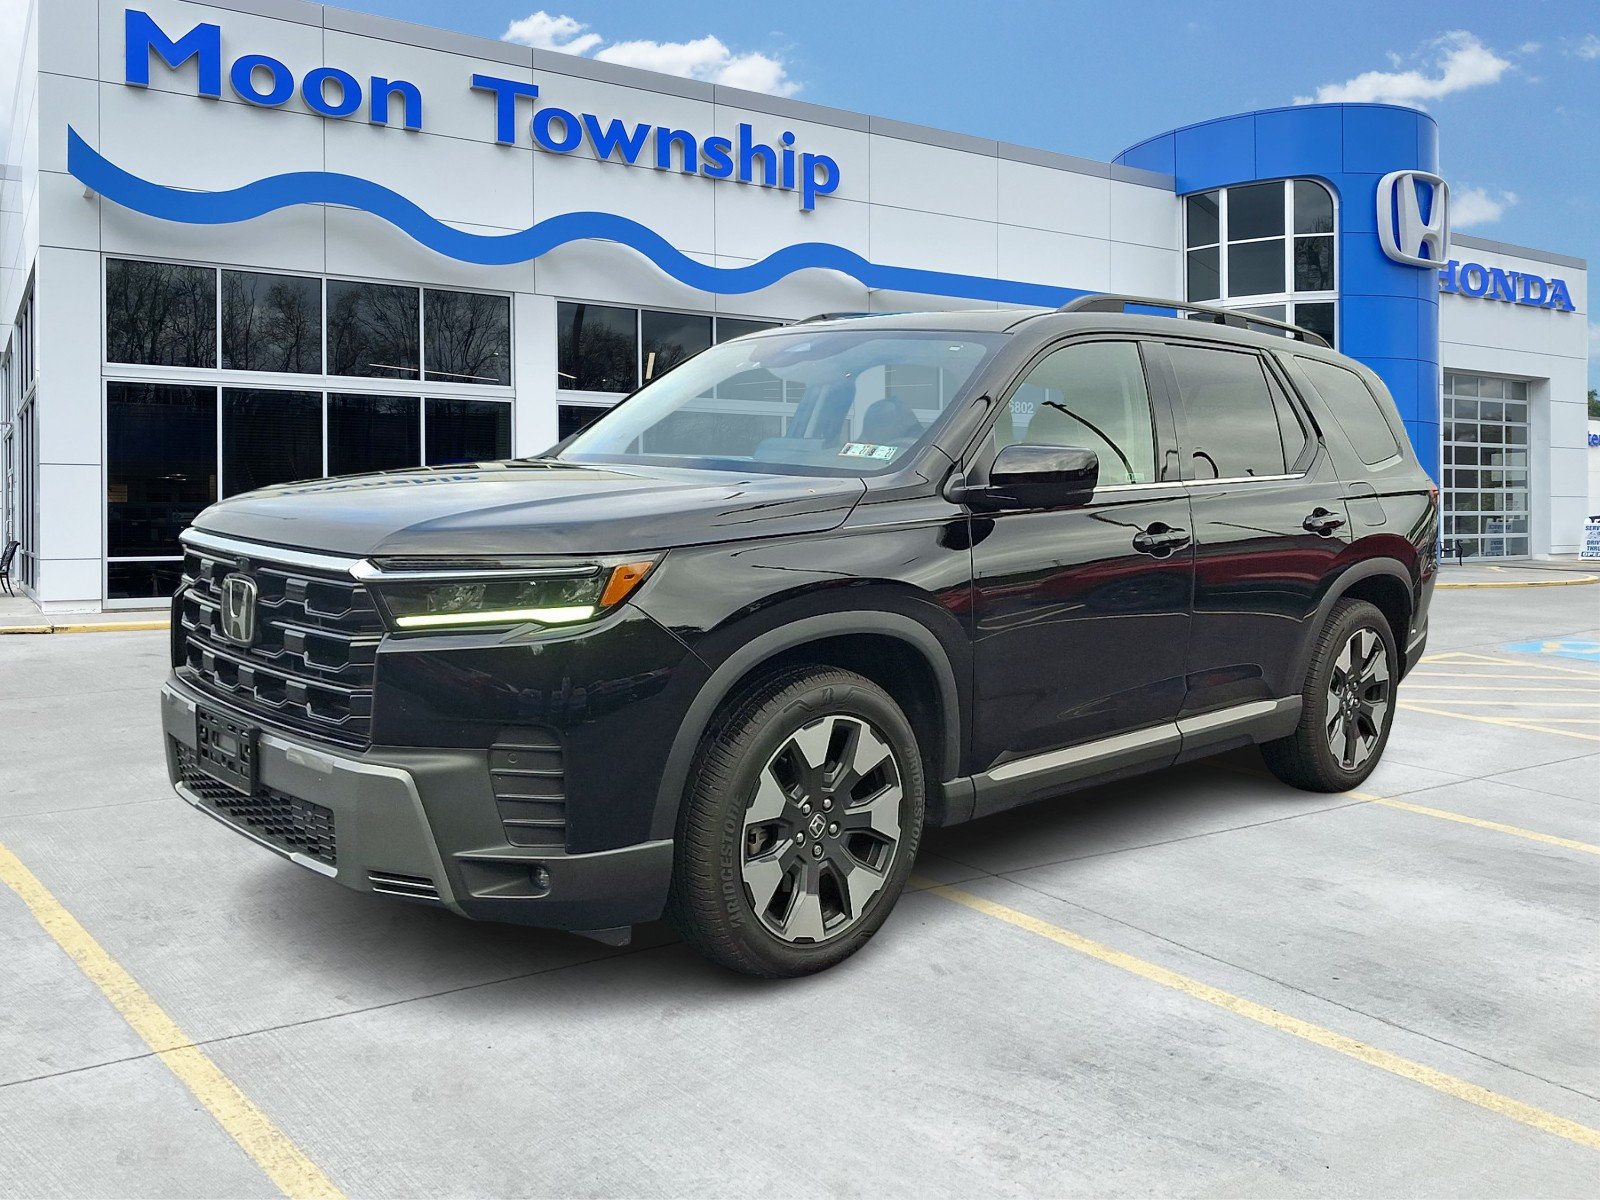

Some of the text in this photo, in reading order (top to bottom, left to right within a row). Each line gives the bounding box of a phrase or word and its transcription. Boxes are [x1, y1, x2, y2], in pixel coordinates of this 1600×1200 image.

[125, 9, 840, 212] Moon Township
[1439, 260, 1576, 312] HONDA
